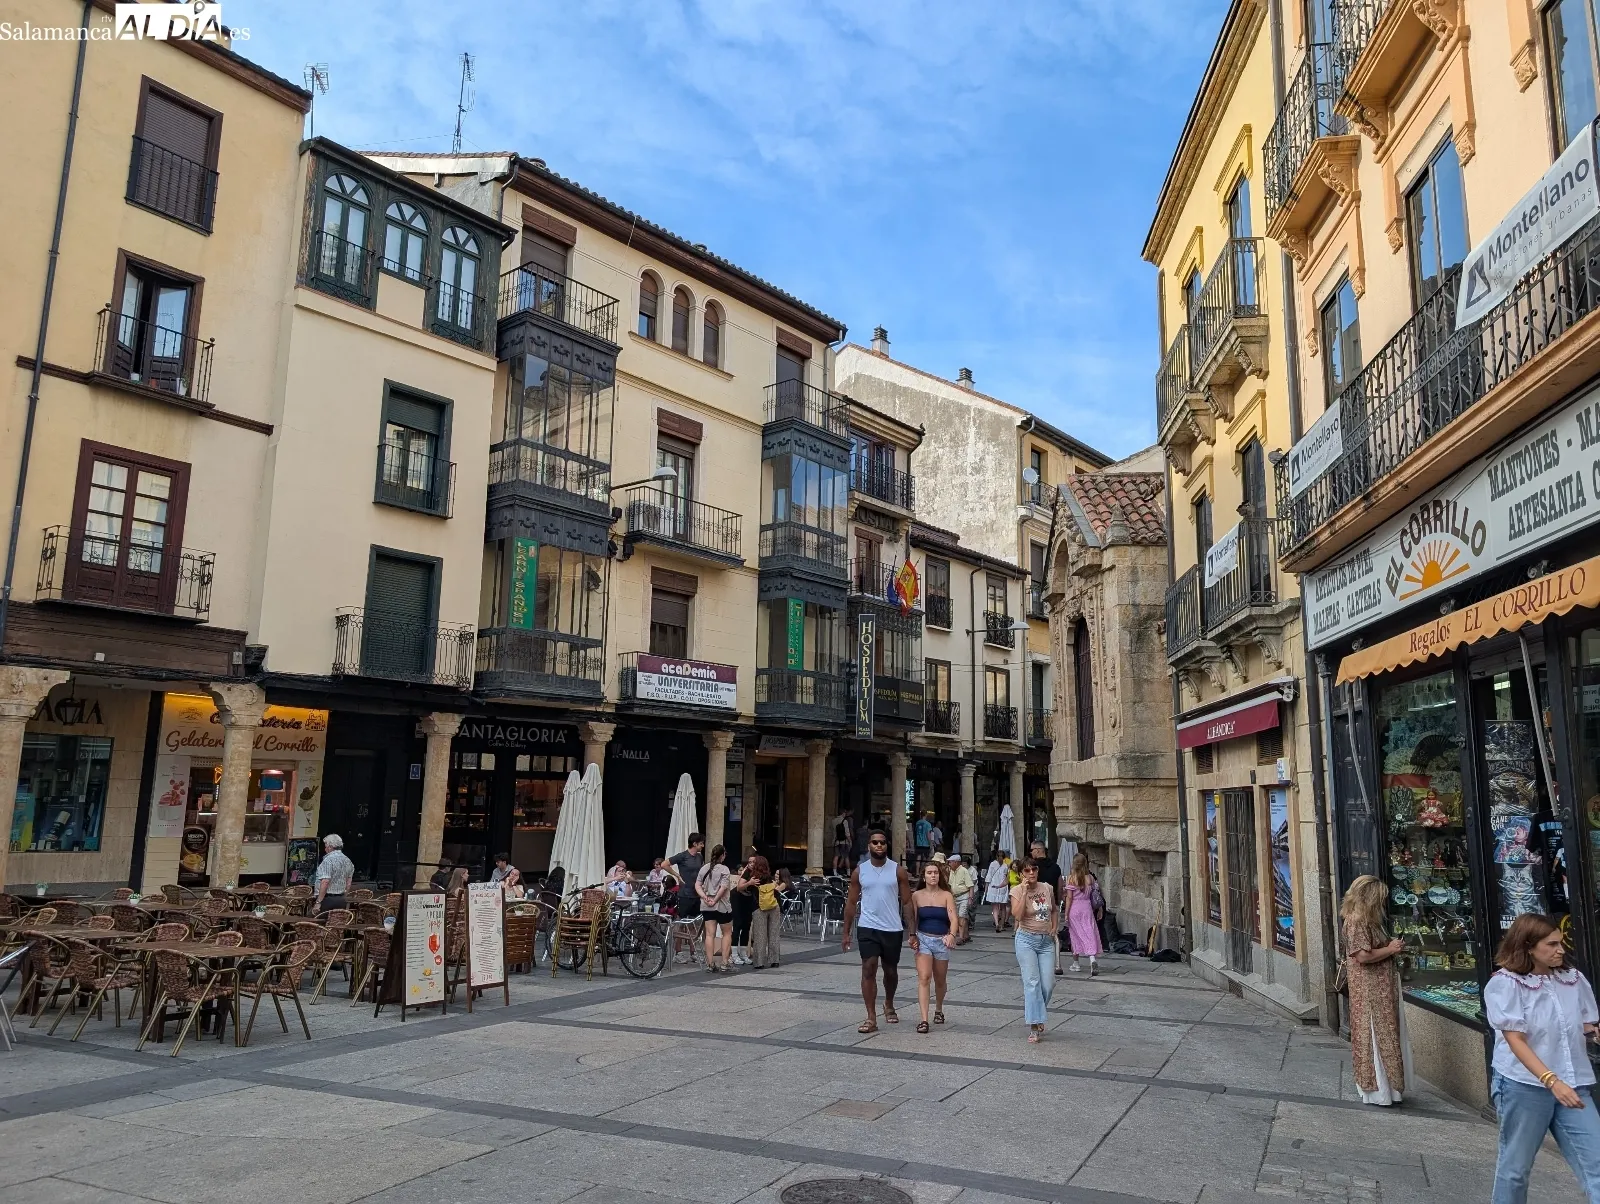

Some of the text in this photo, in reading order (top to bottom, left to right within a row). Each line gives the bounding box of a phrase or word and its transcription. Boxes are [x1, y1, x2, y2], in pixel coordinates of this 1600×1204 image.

[1487, 158, 1590, 271] Montellano
[1548, 188, 1593, 230] urbanas
[1487, 428, 1560, 502] MANTONES
[1508, 470, 1587, 541] ARTESANIA
[1385, 499, 1487, 597] EL CORRILLO
[1313, 600, 1341, 636] MALETAS
[1346, 578, 1382, 620] CARTERAS
[1408, 567, 1586, 656] Regalos EL CORRILLO
[654, 686, 685, 696] FACULTADES
[657, 675, 719, 693] UNIVERSITARIA
[859, 621, 874, 725] HOSPEDIUM
[263, 735, 319, 753] Corrillo
[458, 723, 566, 744] ANTAGLORIA
